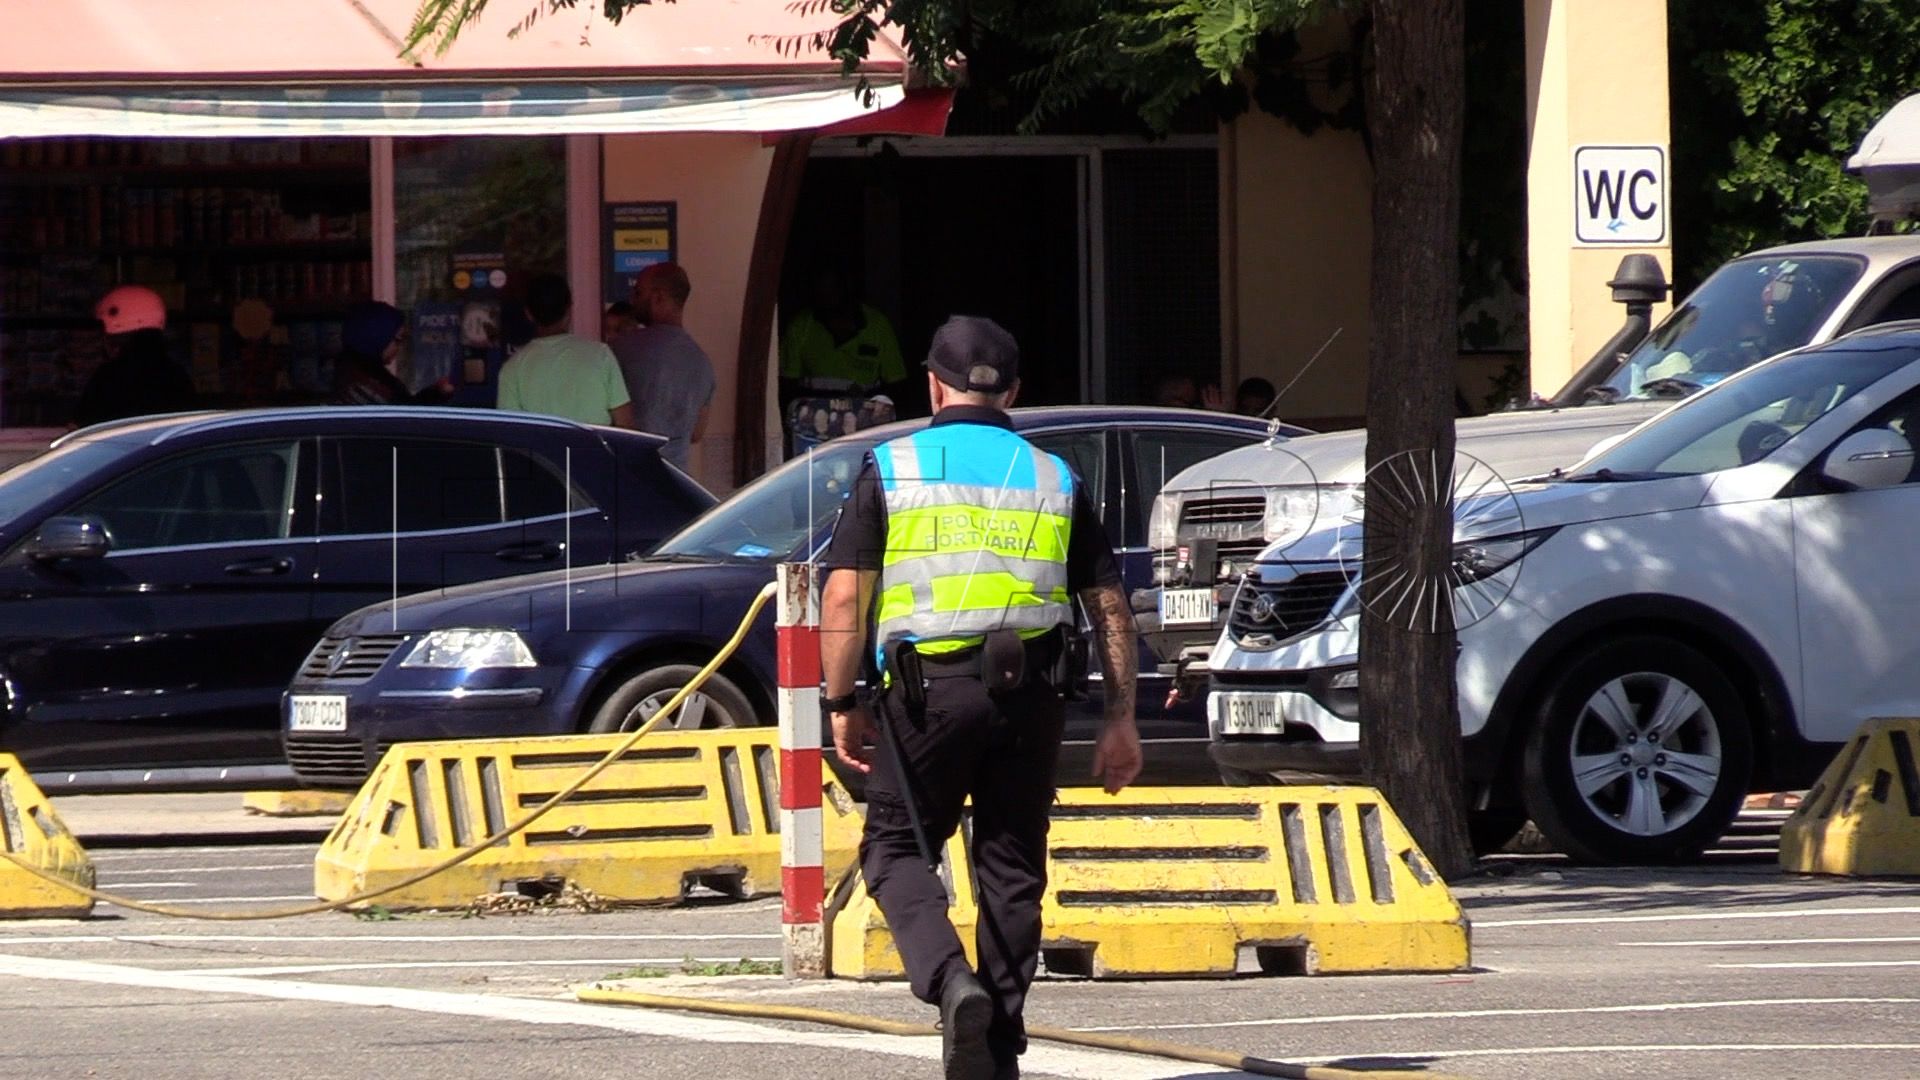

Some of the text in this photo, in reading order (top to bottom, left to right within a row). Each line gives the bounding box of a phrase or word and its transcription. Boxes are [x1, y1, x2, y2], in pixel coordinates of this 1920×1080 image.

[1583, 168, 1657, 220] WC
[941, 513, 1020, 533] POLICIA
[1226, 700, 1281, 728] 1330 HHL
